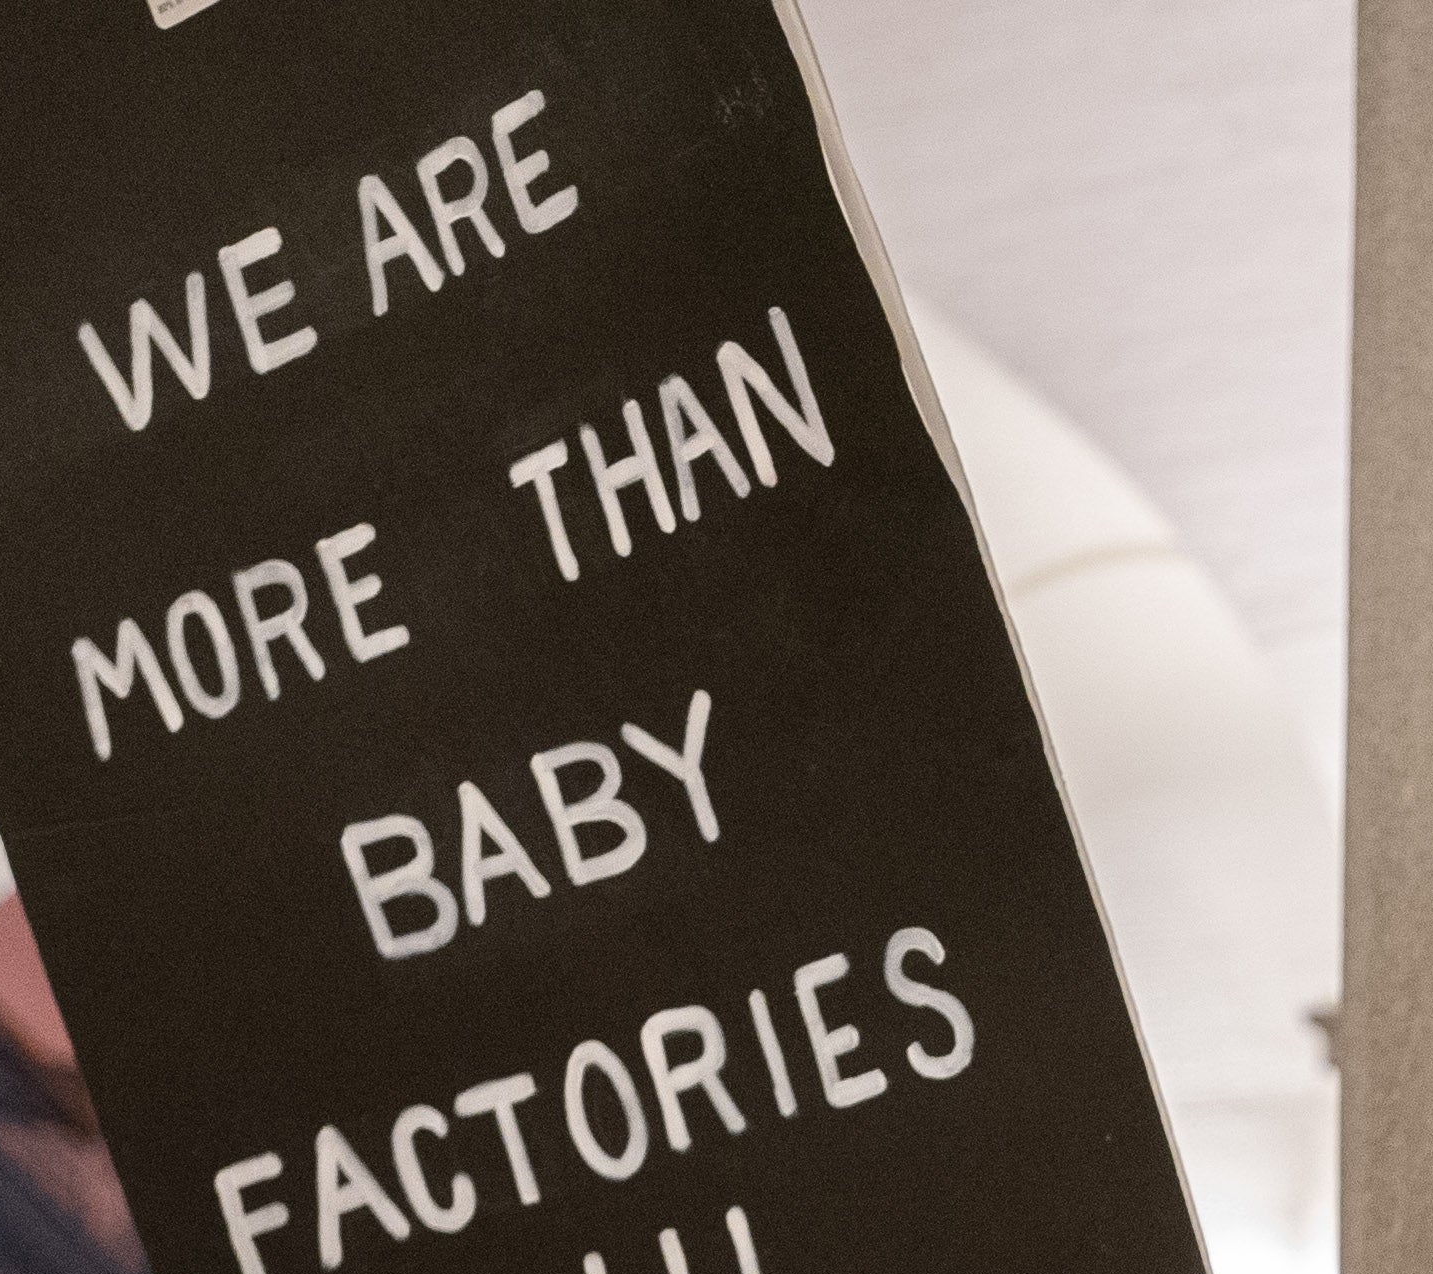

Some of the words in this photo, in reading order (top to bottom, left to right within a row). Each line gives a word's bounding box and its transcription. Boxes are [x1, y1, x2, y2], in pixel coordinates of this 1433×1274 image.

[76, 224, 320, 433] WE
[355, 87, 580, 318] ARE
[69, 521, 412, 761] MORE
[507, 305, 837, 583] THAN
[338, 688, 722, 961] BABY
